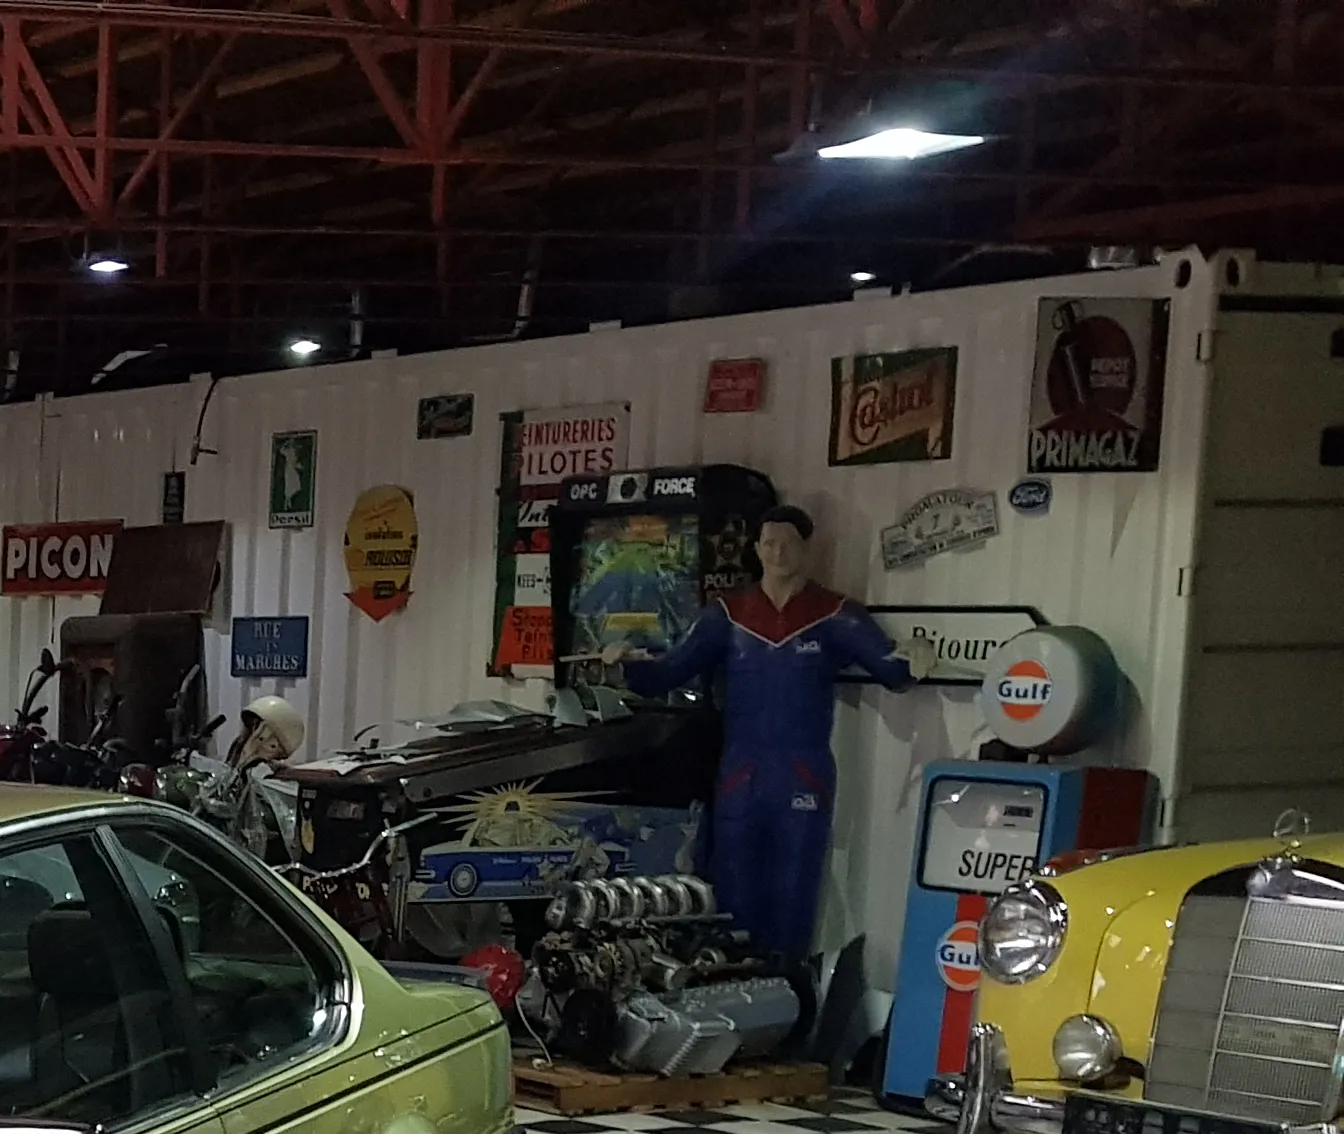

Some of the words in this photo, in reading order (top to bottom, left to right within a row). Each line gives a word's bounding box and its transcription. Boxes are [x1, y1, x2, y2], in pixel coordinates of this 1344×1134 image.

[1030, 429, 1141, 468] PRIMAGAZ
[6, 534, 112, 582] PICON
[998, 680, 1051, 700] Gulf
[958, 849, 1038, 882] SUPER
[940, 944, 980, 966] Gul
